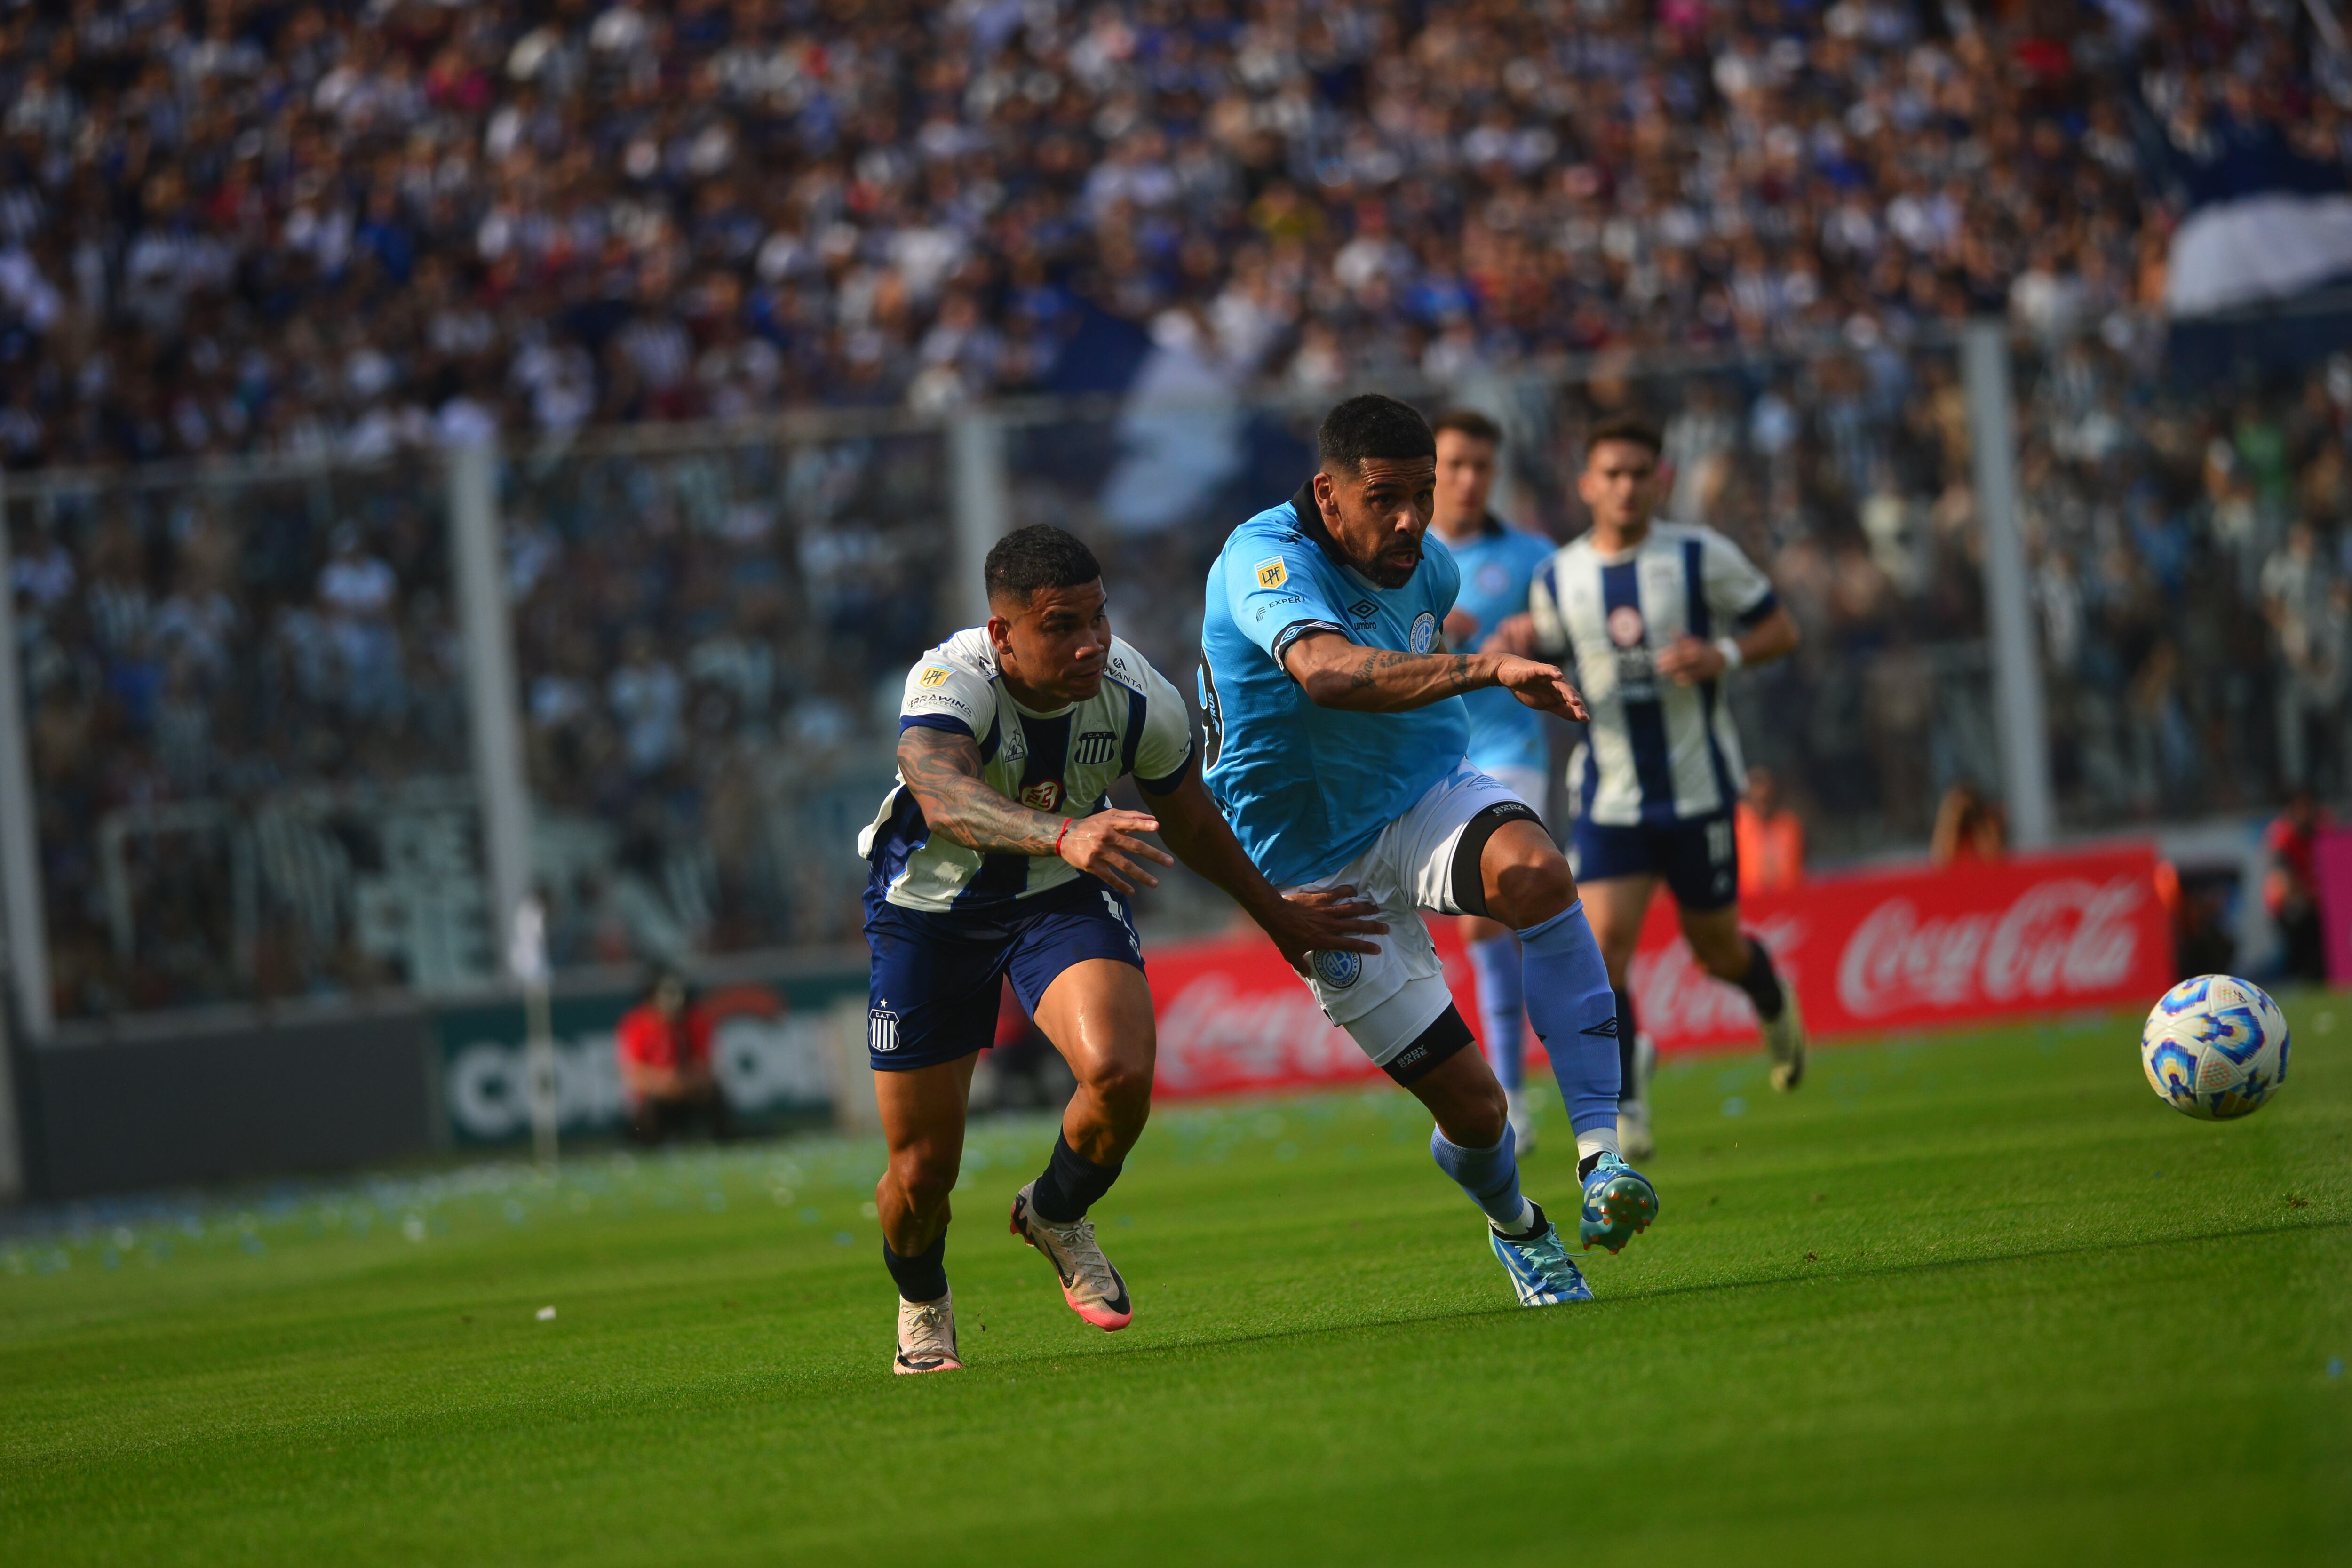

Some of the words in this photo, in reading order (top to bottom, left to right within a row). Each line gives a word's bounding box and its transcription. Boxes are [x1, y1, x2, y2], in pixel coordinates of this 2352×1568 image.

[1354, 620, 1377, 630] umbro
[1412, 615, 1426, 636] ATLETICO
[1104, 666, 1142, 691] VANTA
[1319, 967, 1330, 981] CLUB
[1336, 971, 1358, 986] CORDOBA
[1397, 1044, 1424, 1064] BODY
[1400, 1049, 1428, 1068] CARE
